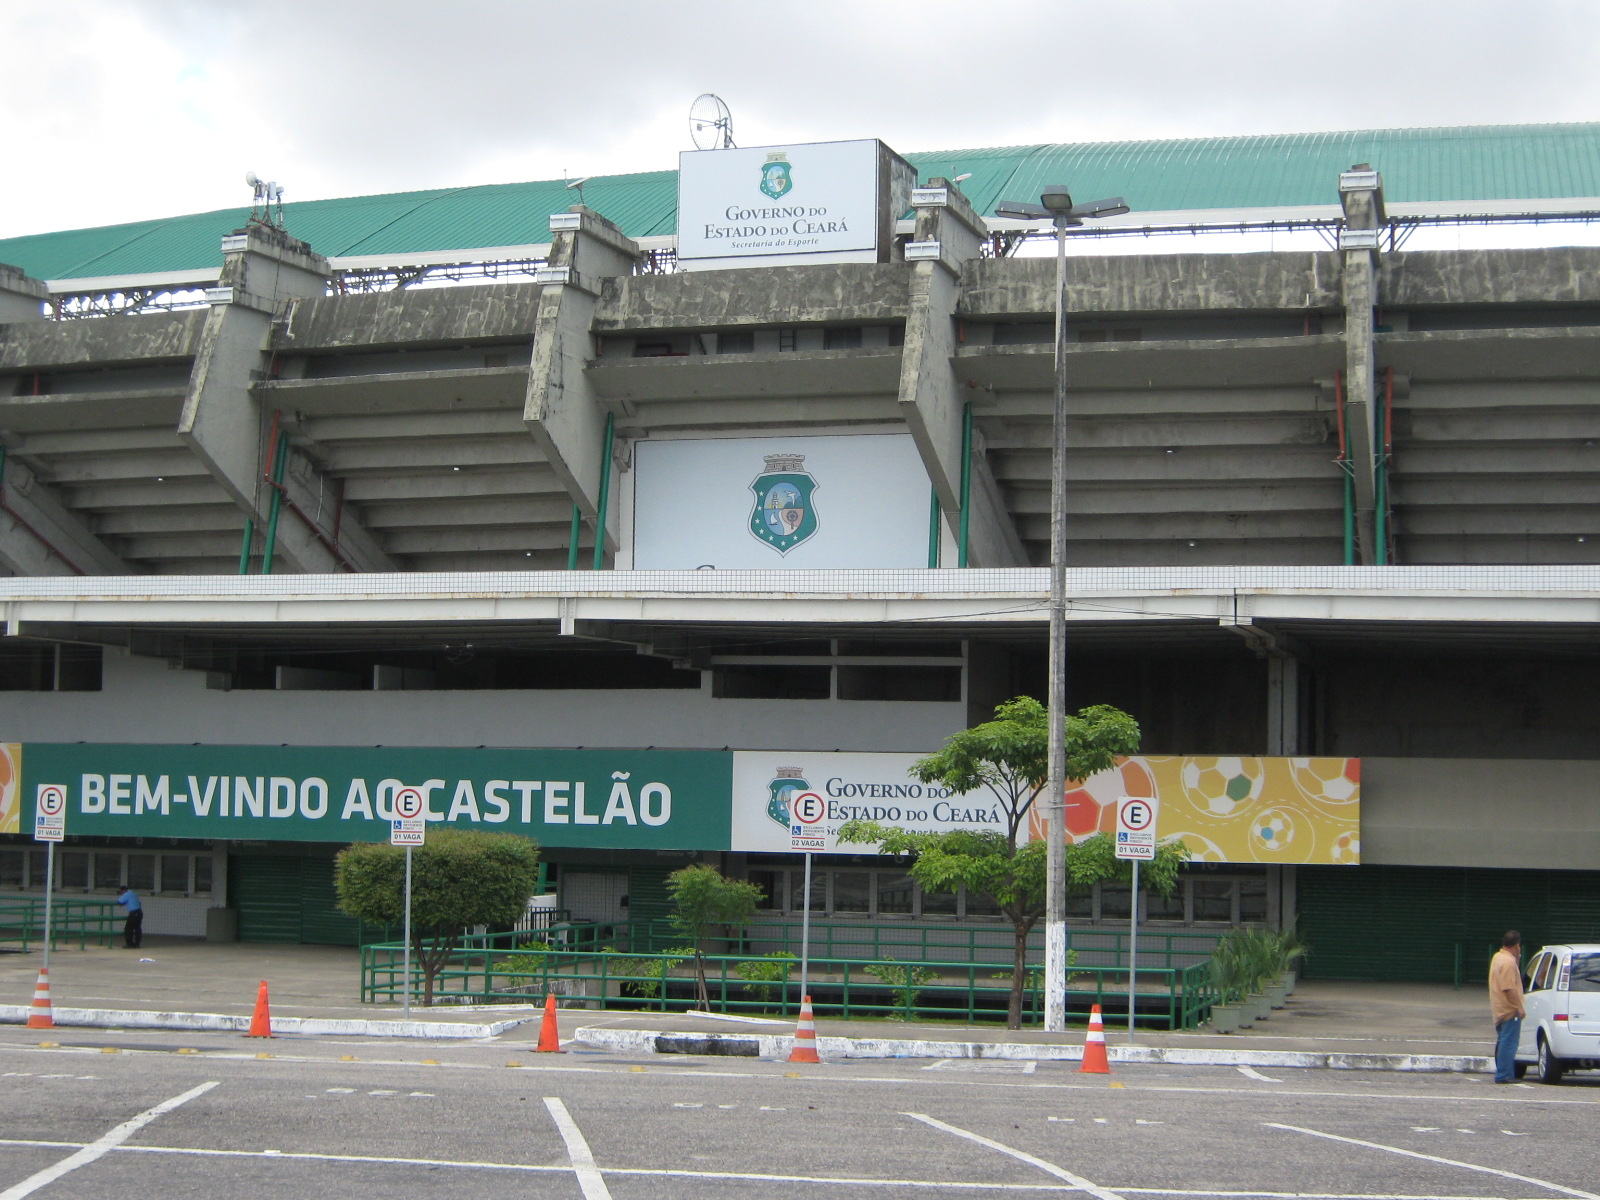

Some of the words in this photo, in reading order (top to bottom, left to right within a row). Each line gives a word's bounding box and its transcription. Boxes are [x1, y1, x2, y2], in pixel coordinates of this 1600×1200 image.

[725, 205, 805, 221] GOVERNO
[808, 207, 827, 217] DO
[703, 224, 767, 239] ESTADO
[770, 226, 789, 236] DO
[792, 217, 849, 235] CEARÁ
[731, 240, 773, 249] Secretaria
[788, 238, 819, 247] Esporte
[825, 777, 923, 799] GOVERNO
[926, 787, 950, 799] DO
[47, 793, 56, 809] E
[81, 773, 329, 819] BEM-VINDO
[422, 770, 672, 826] CASTELÃO
[404, 795, 413, 811] E
[803, 799, 815, 817] E
[827, 800, 902, 821] ESTADO
[906, 810, 928, 822] DO
[933, 802, 1001, 823] CEARÁ
[1130, 806, 1142, 824] E
